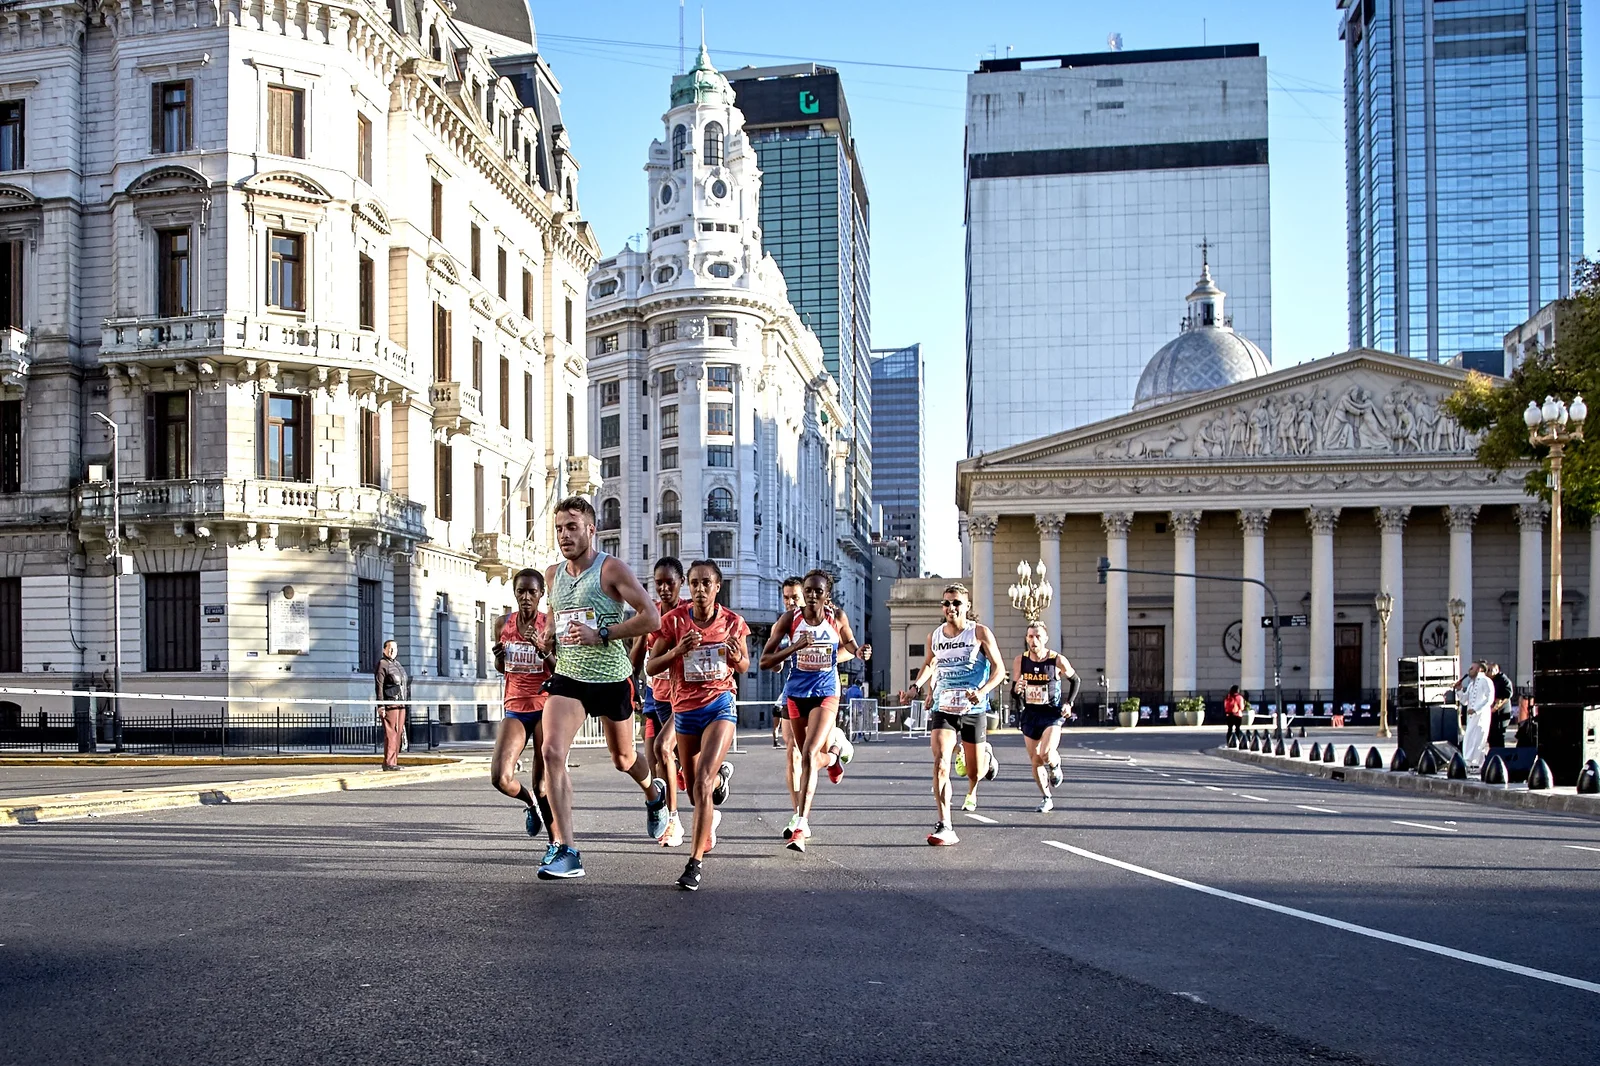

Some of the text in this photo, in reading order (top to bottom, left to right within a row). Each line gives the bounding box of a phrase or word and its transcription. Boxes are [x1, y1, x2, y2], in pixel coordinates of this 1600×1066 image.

[938, 641, 965, 650] Mica
[509, 651, 536, 664] TANUI
[698, 657, 711, 670] 71
[1023, 673, 1049, 681] BRASIL
[951, 697, 960, 705] 41
